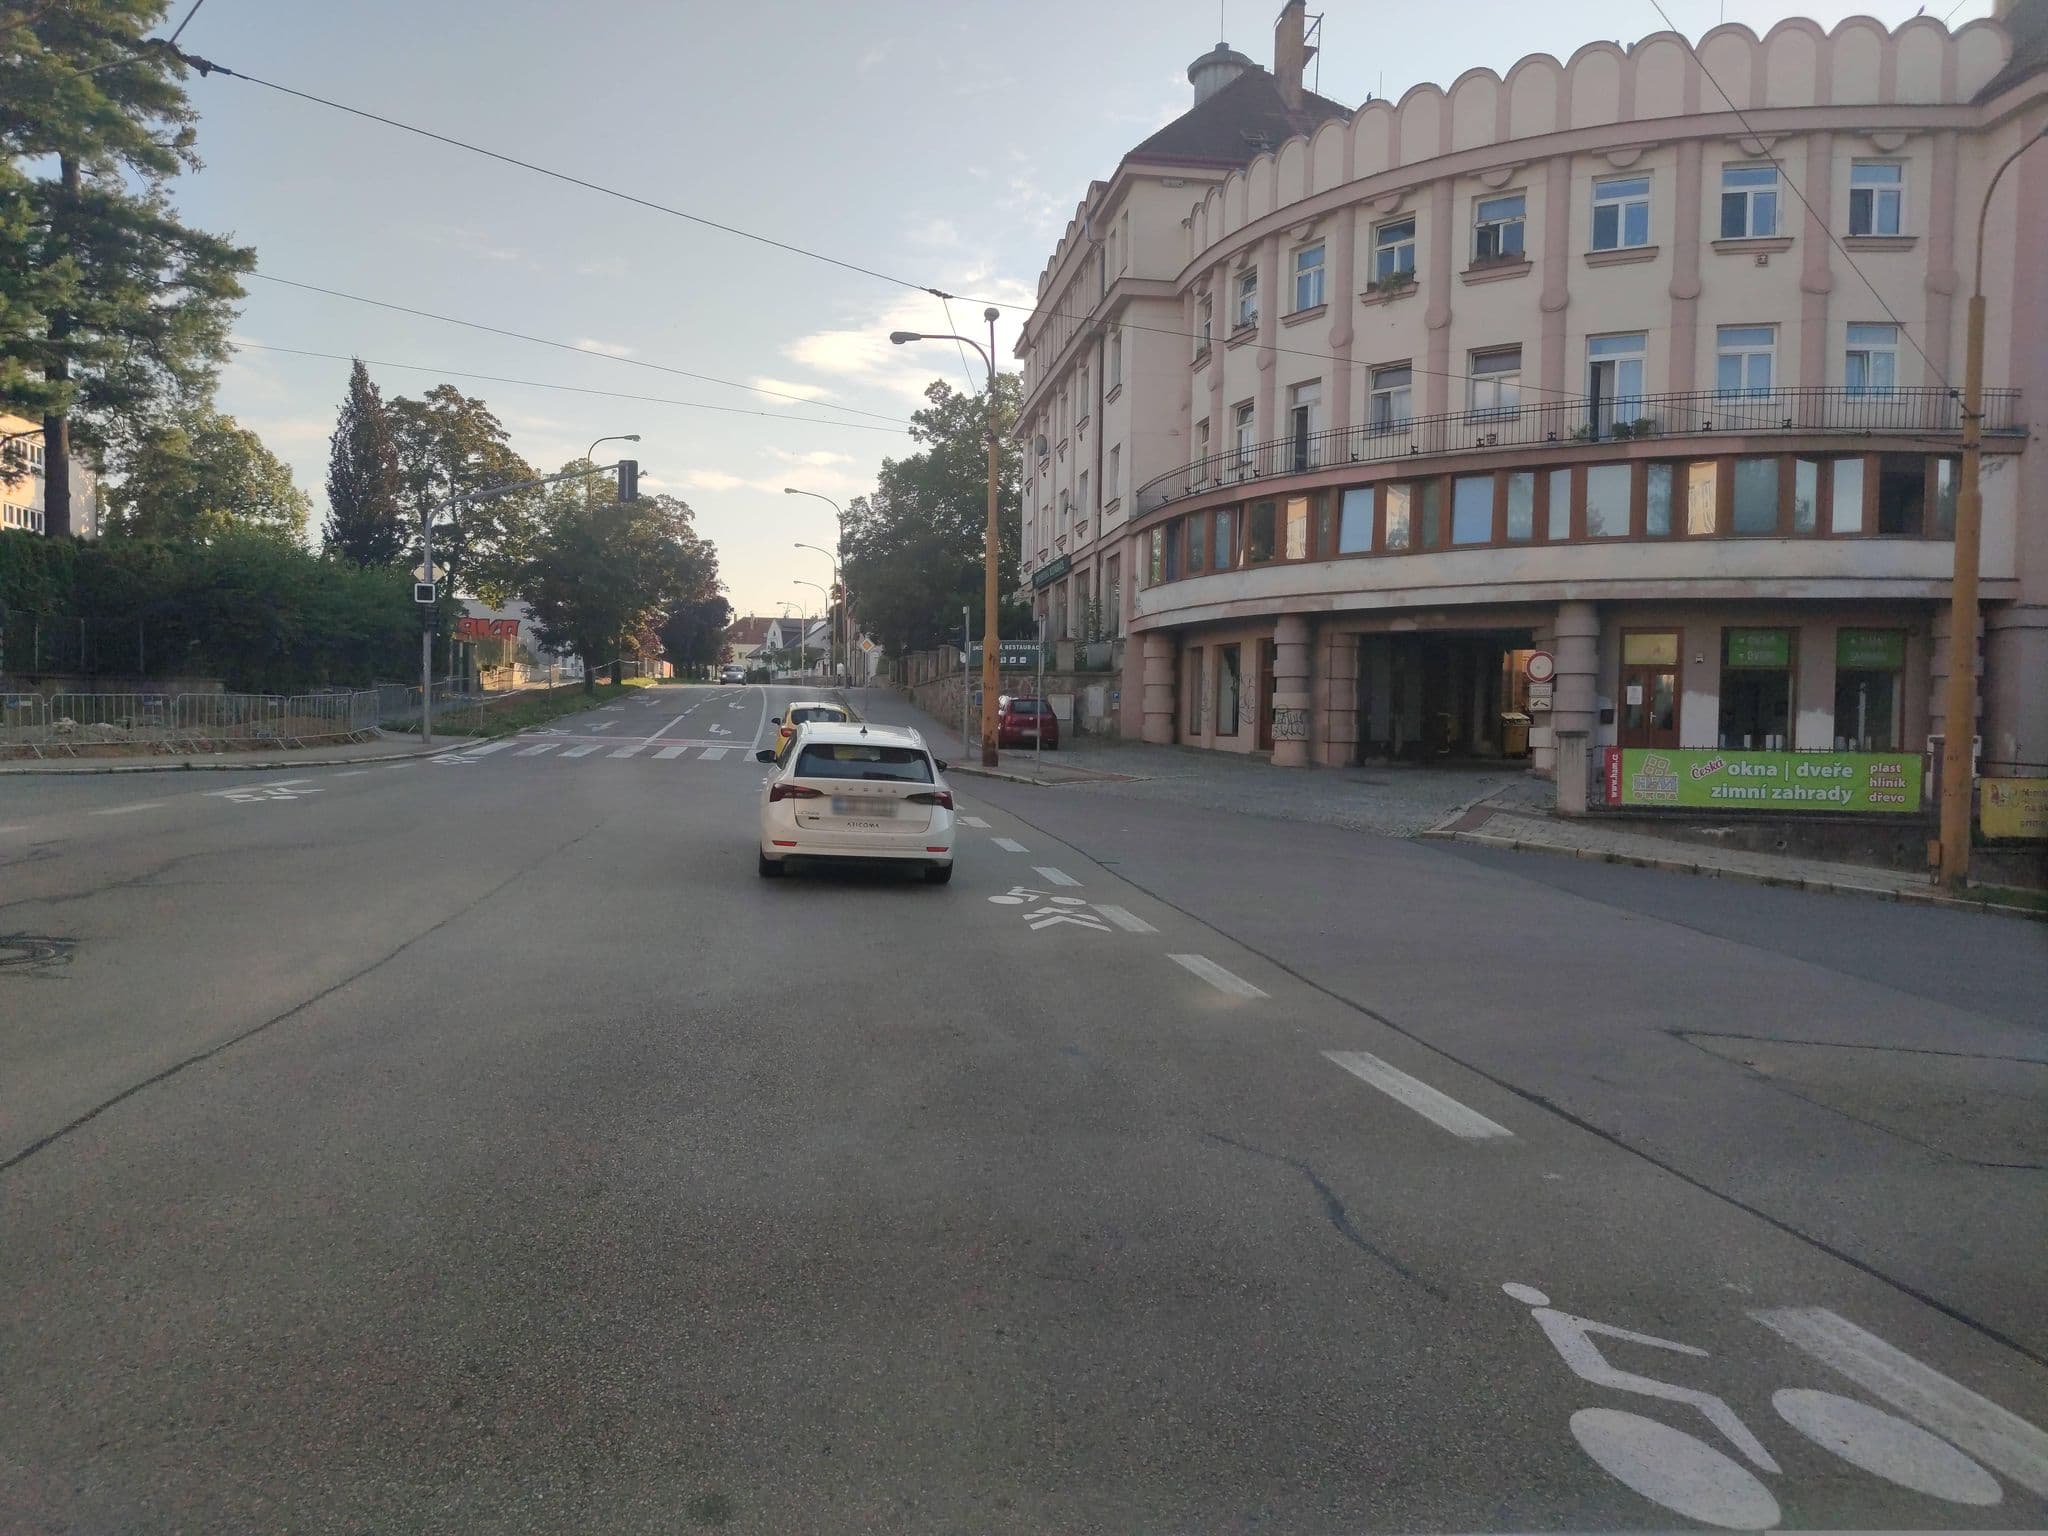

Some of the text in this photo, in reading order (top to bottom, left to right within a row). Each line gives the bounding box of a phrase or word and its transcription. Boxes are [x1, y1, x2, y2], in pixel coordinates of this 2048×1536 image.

[1610, 753, 1619, 798] www.ham.cz
[1691, 756, 1725, 779] Česká
[1727, 760, 1853, 778] okna dveře
[1869, 763, 1901, 775] plast
[1711, 784, 1854, 805] zimní zahrady
[1868, 792, 1906, 803] dřevo
